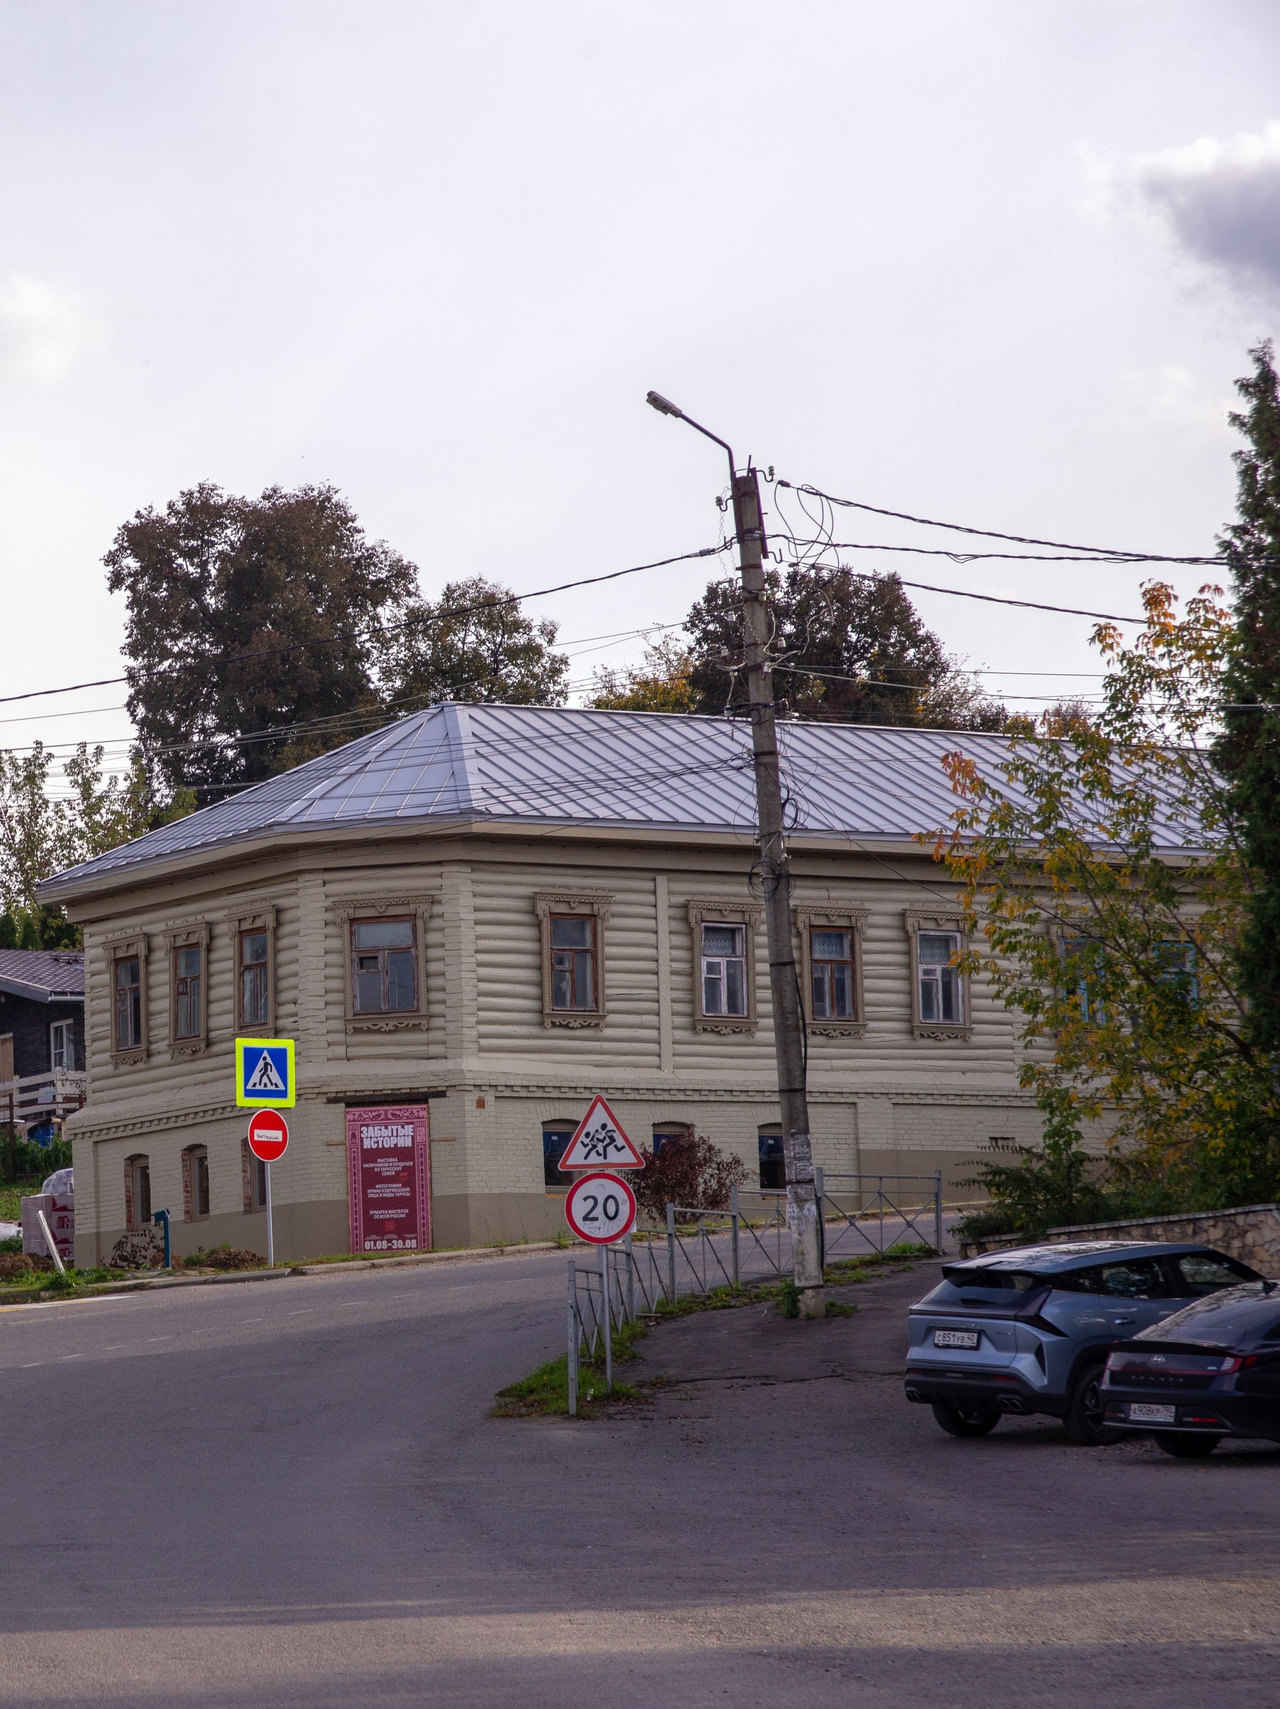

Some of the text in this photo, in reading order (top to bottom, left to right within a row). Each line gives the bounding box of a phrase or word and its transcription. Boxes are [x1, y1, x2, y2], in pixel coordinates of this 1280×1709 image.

[361, 1125, 414, 1138] ЗАБЫТЫЕ
[363, 1136, 412, 1149] ИСТОРИИ
[582, 1194, 620, 1222] 20
